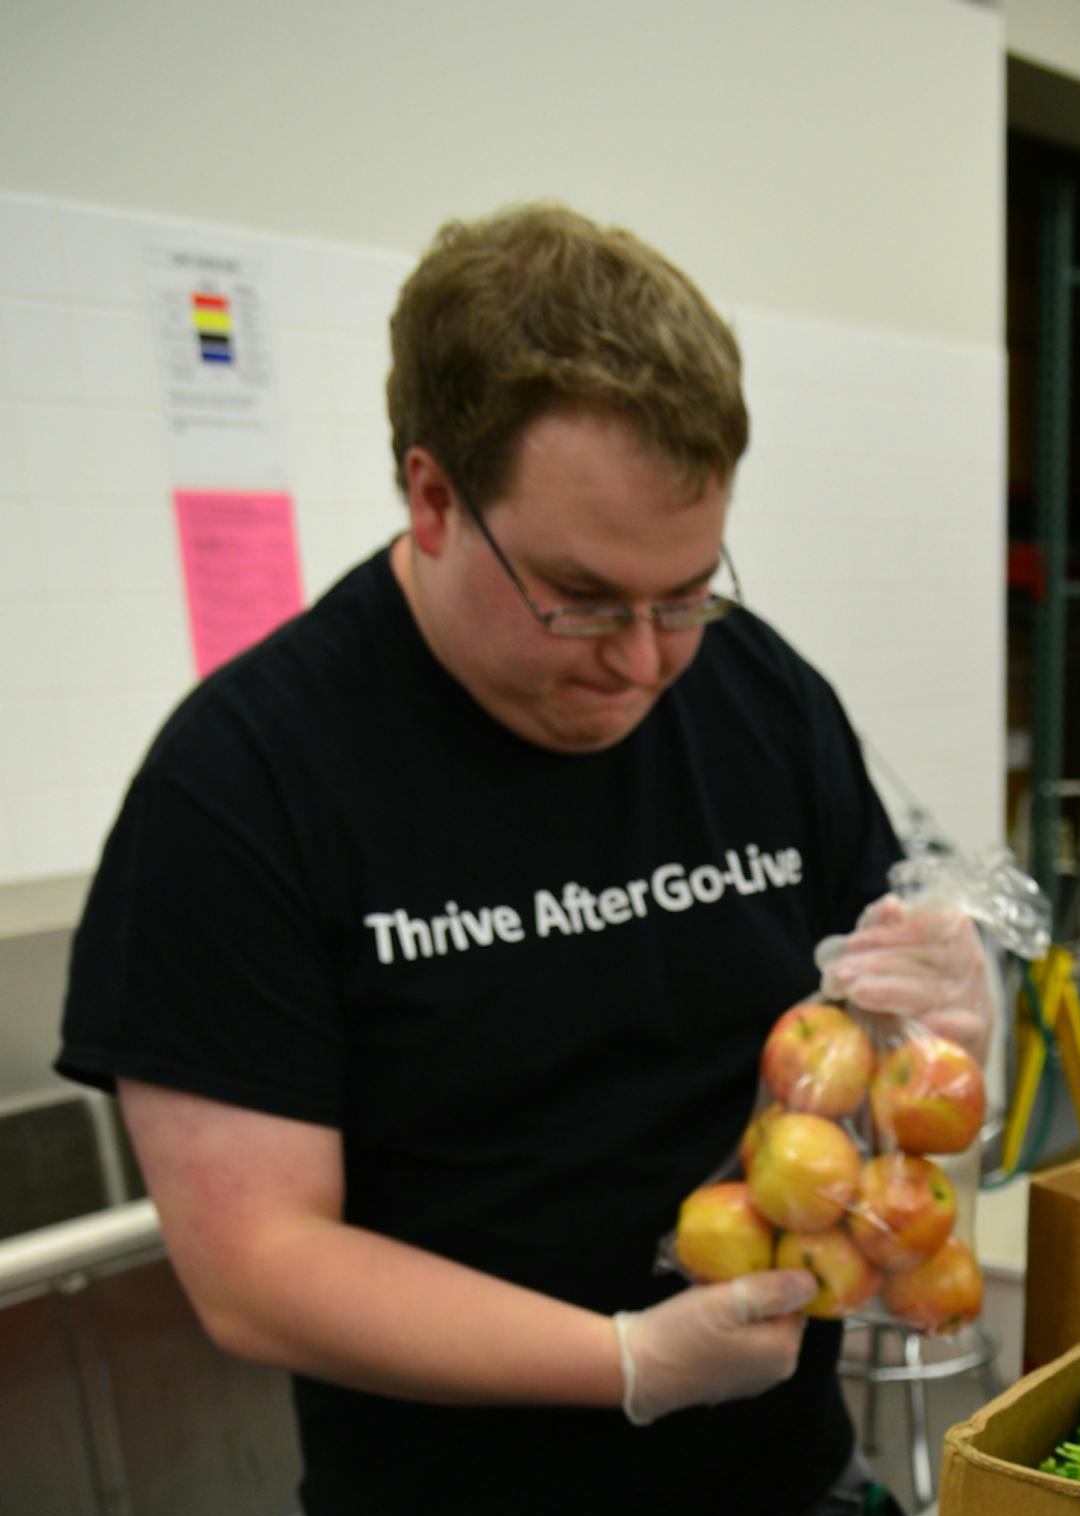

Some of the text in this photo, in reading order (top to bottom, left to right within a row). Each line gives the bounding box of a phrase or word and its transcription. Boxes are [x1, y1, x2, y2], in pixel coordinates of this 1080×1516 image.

[364, 843, 803, 965] Thrive After Go-Live
